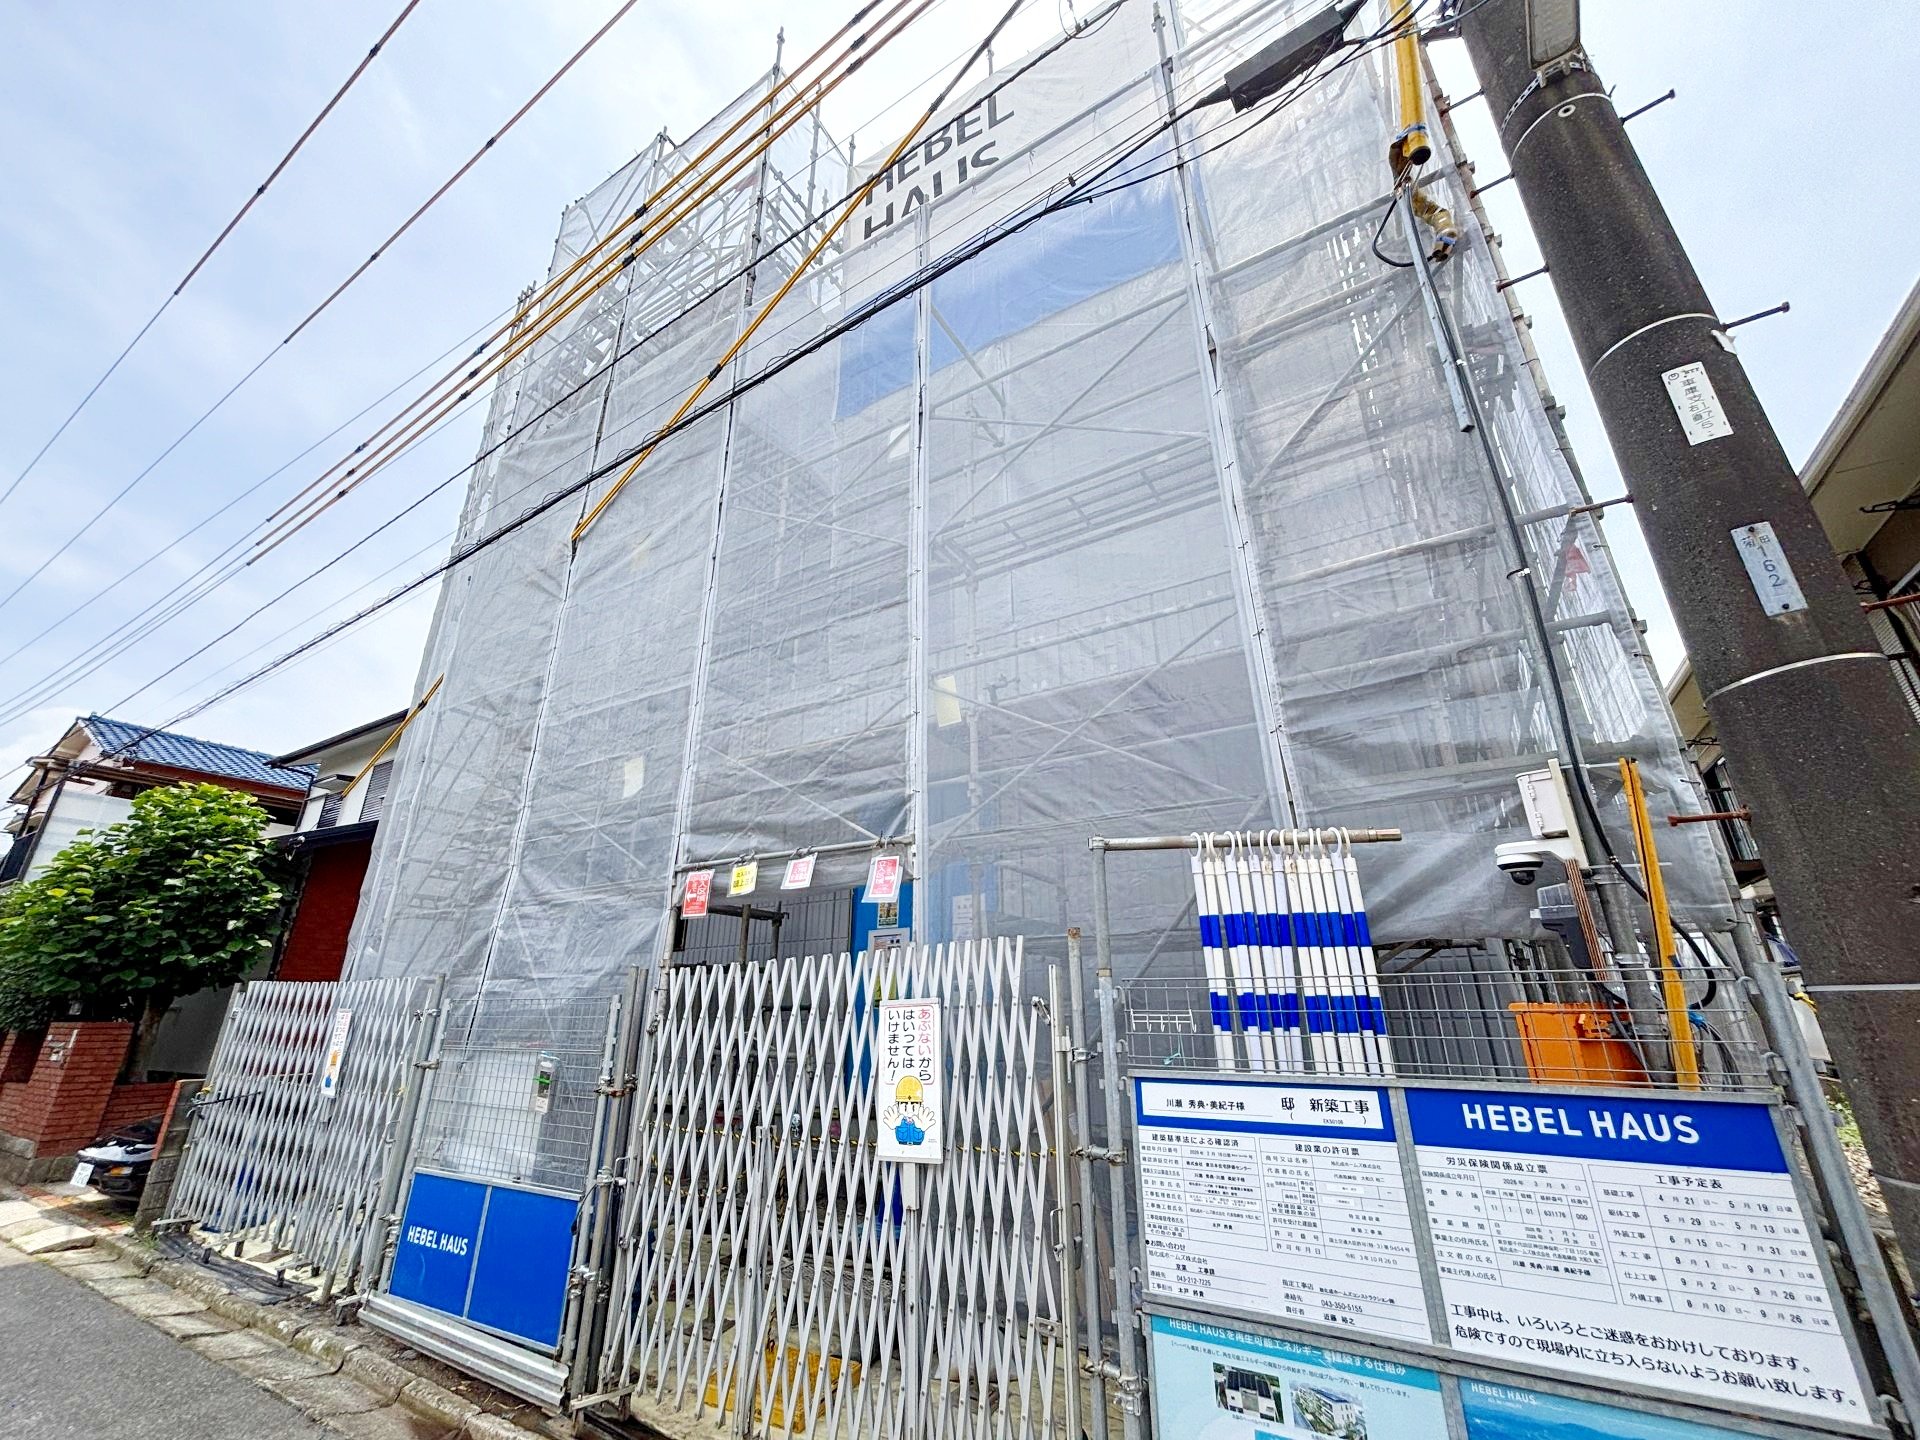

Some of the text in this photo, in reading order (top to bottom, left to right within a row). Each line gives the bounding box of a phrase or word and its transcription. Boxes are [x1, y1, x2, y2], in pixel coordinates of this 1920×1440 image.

[1757, 546, 1784, 587] 162
[902, 1009, 915, 1068] はいっては
[917, 1008, 932, 1081] あぶないから
[1281, 1097, 1295, 1110] 邸
[1309, 1098, 1370, 1114] 新築工事
[1462, 1103, 1700, 1144] HEBEL HAUS
[1151, 1133, 1238, 1147] 建築基準法による確認済
[1294, 1143, 1360, 1156] 建設業の許可票
[1445, 1156, 1549, 1174] 労災保険関係成立票
[1653, 1174, 1723, 1189] 工事予定表
[1602, 1188, 1635, 1198] 基礎工事
[407, 1225, 468, 1256] HEBEL HAUS
[1612, 1228, 1646, 1239] 外装工事
[1150, 1239, 1185, 1251] お問い合わせ
[1148, 1249, 1207, 1265] 旭化成ホームズ株式会社
[1436, 1249, 1493, 1264] 注文者の氏名
[1617, 1250, 1652, 1261] 木工事
[1149, 1269, 1166, 1278] 連絡先
[1439, 1266, 1496, 1281] 事業主代理人の氏名
[1623, 1270, 1658, 1282] 仕上工事
[1281, 1278, 1314, 1290] 指定工事店
[1283, 1292, 1363, 1313] 連絡先 043-350-5155
[1628, 1291, 1664, 1304] 外構工事
[1285, 1305, 1305, 1316] 責任者
[1169, 1318, 1198, 1333] HEBEL
[1449, 1303, 1814, 1375] 工事中は、いろいろとご迷惑をおかけしております。
[1453, 1323, 1859, 1407] 危険ですので現場内に立ち入らないようお願い致します。
[1471, 1383, 1505, 1398] HEBEL
[1507, 1391, 1537, 1405] HAUS
